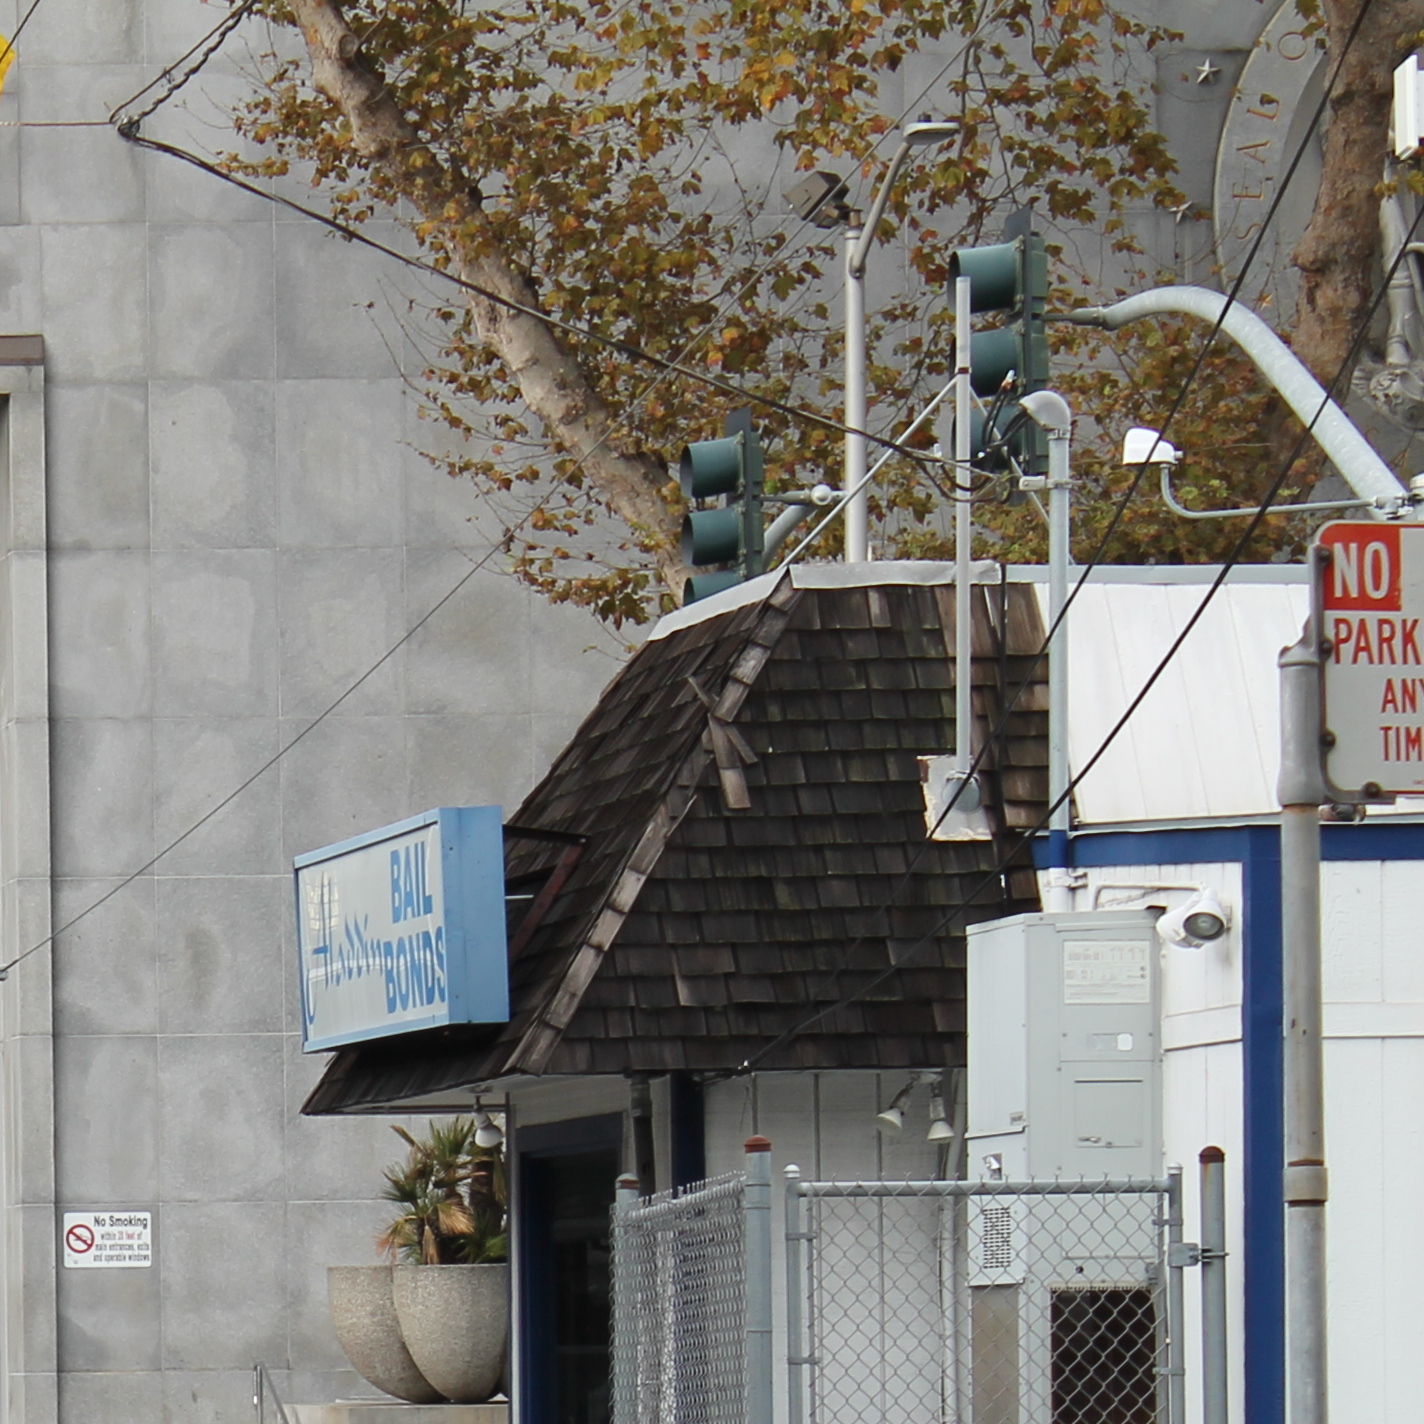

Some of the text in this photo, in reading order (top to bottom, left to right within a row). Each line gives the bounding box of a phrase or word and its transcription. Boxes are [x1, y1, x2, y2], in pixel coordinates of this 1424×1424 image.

[1333, 541, 1390, 599] NO
[390, 841, 433, 924] BAIL
[382, 925, 447, 1014] BONDS
[93, 1215, 148, 1229] No Smoking
